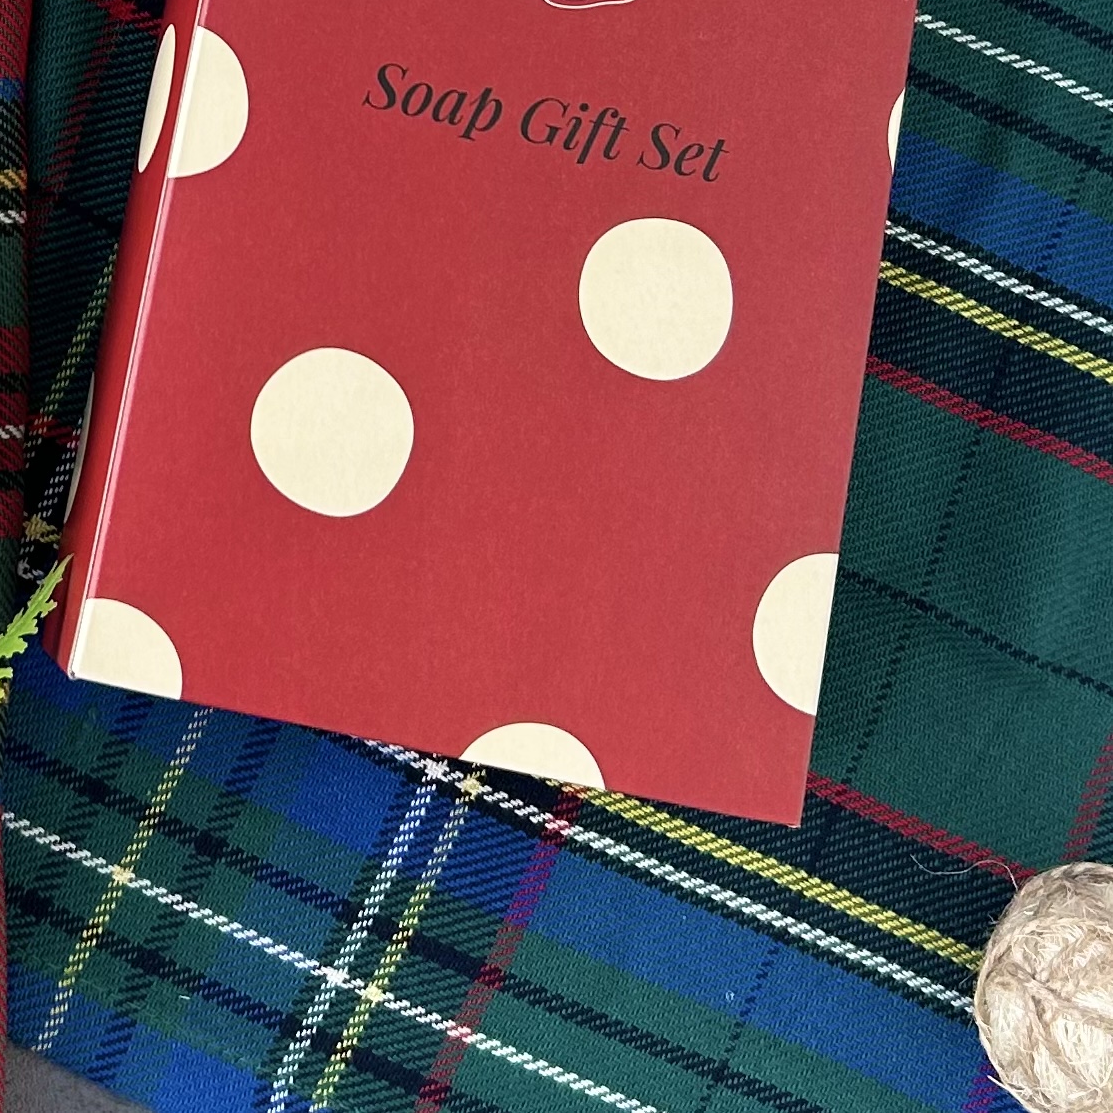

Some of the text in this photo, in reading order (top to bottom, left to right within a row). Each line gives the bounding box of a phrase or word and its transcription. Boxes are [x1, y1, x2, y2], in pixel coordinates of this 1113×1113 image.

[362, 62, 730, 183] Soap Gift Set
